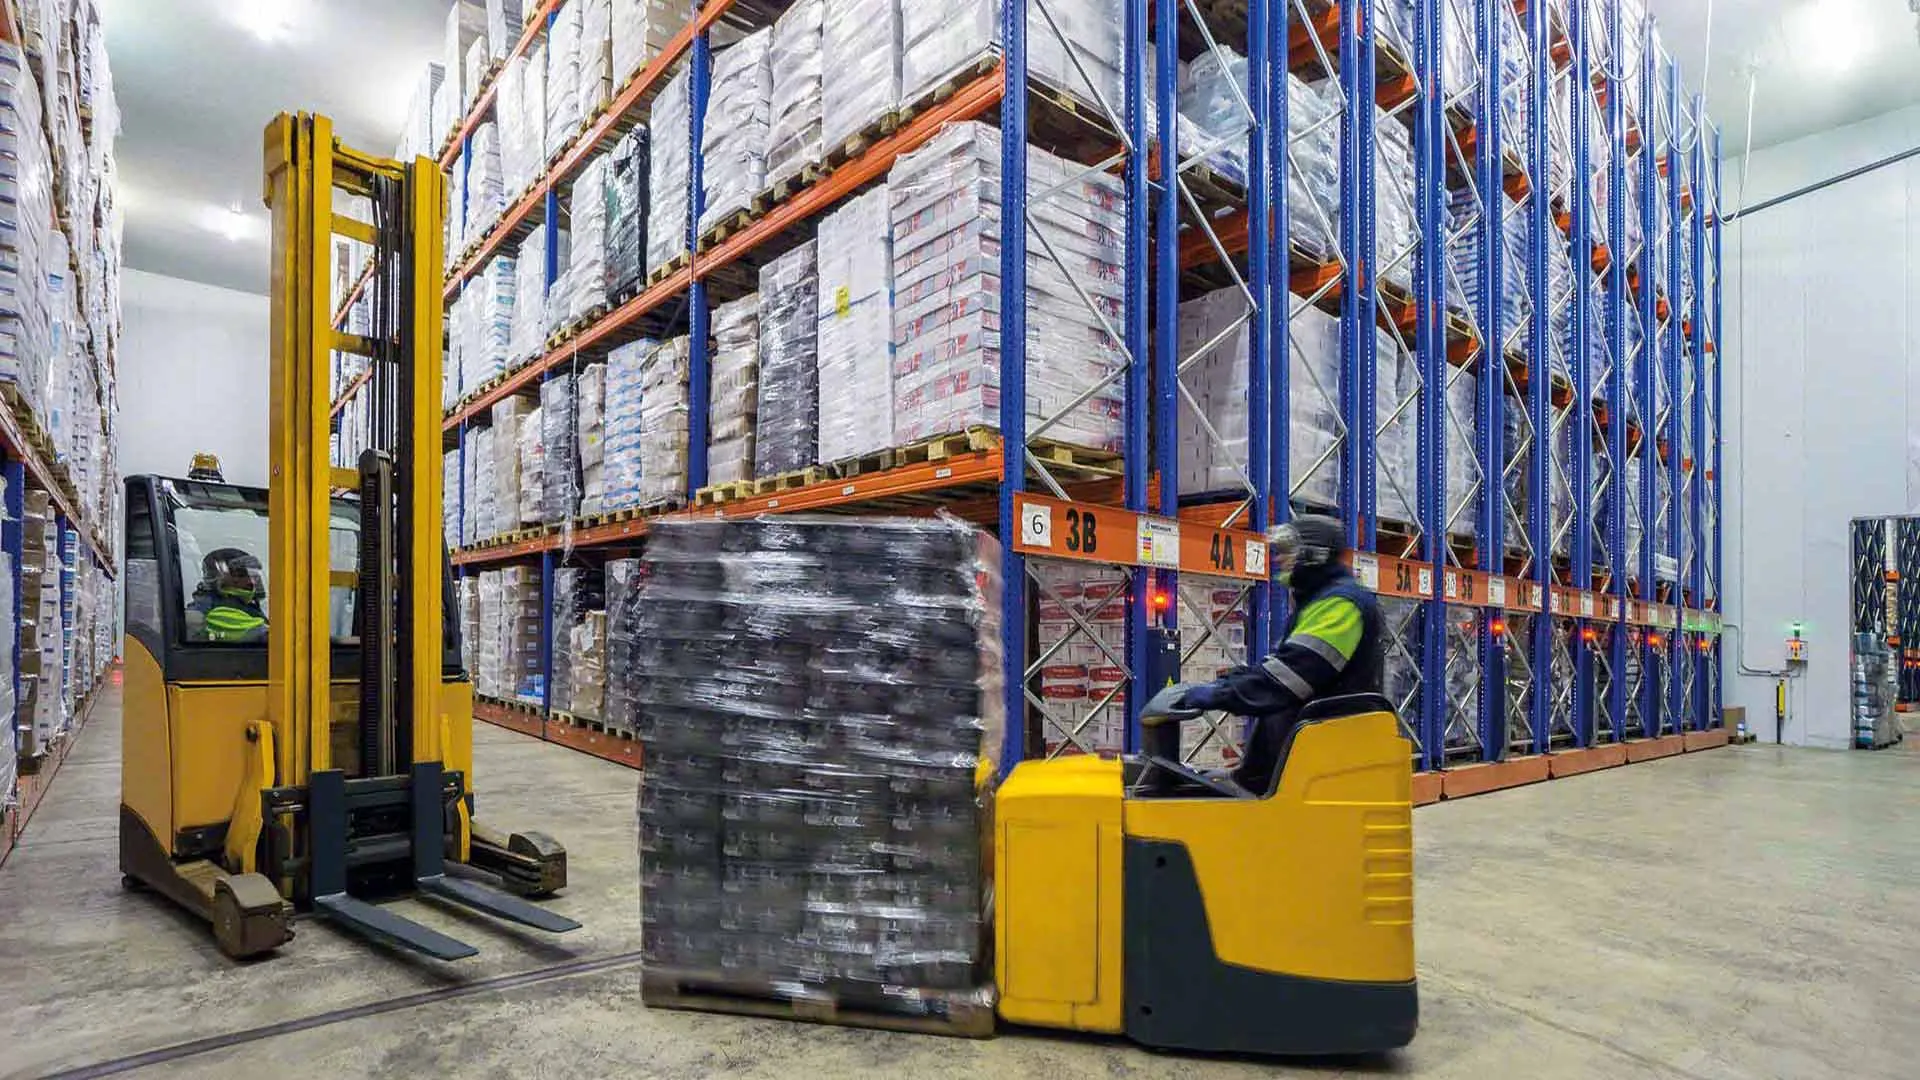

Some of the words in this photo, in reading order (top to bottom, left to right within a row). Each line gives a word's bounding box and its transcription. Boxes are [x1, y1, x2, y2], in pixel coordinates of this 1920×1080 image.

[1032, 514, 1044, 535] 6
[1066, 508, 1097, 553] 3B
[1210, 532, 1234, 570] 4A
[1253, 548, 1261, 566] 7
[1396, 563, 1411, 592] 5A
